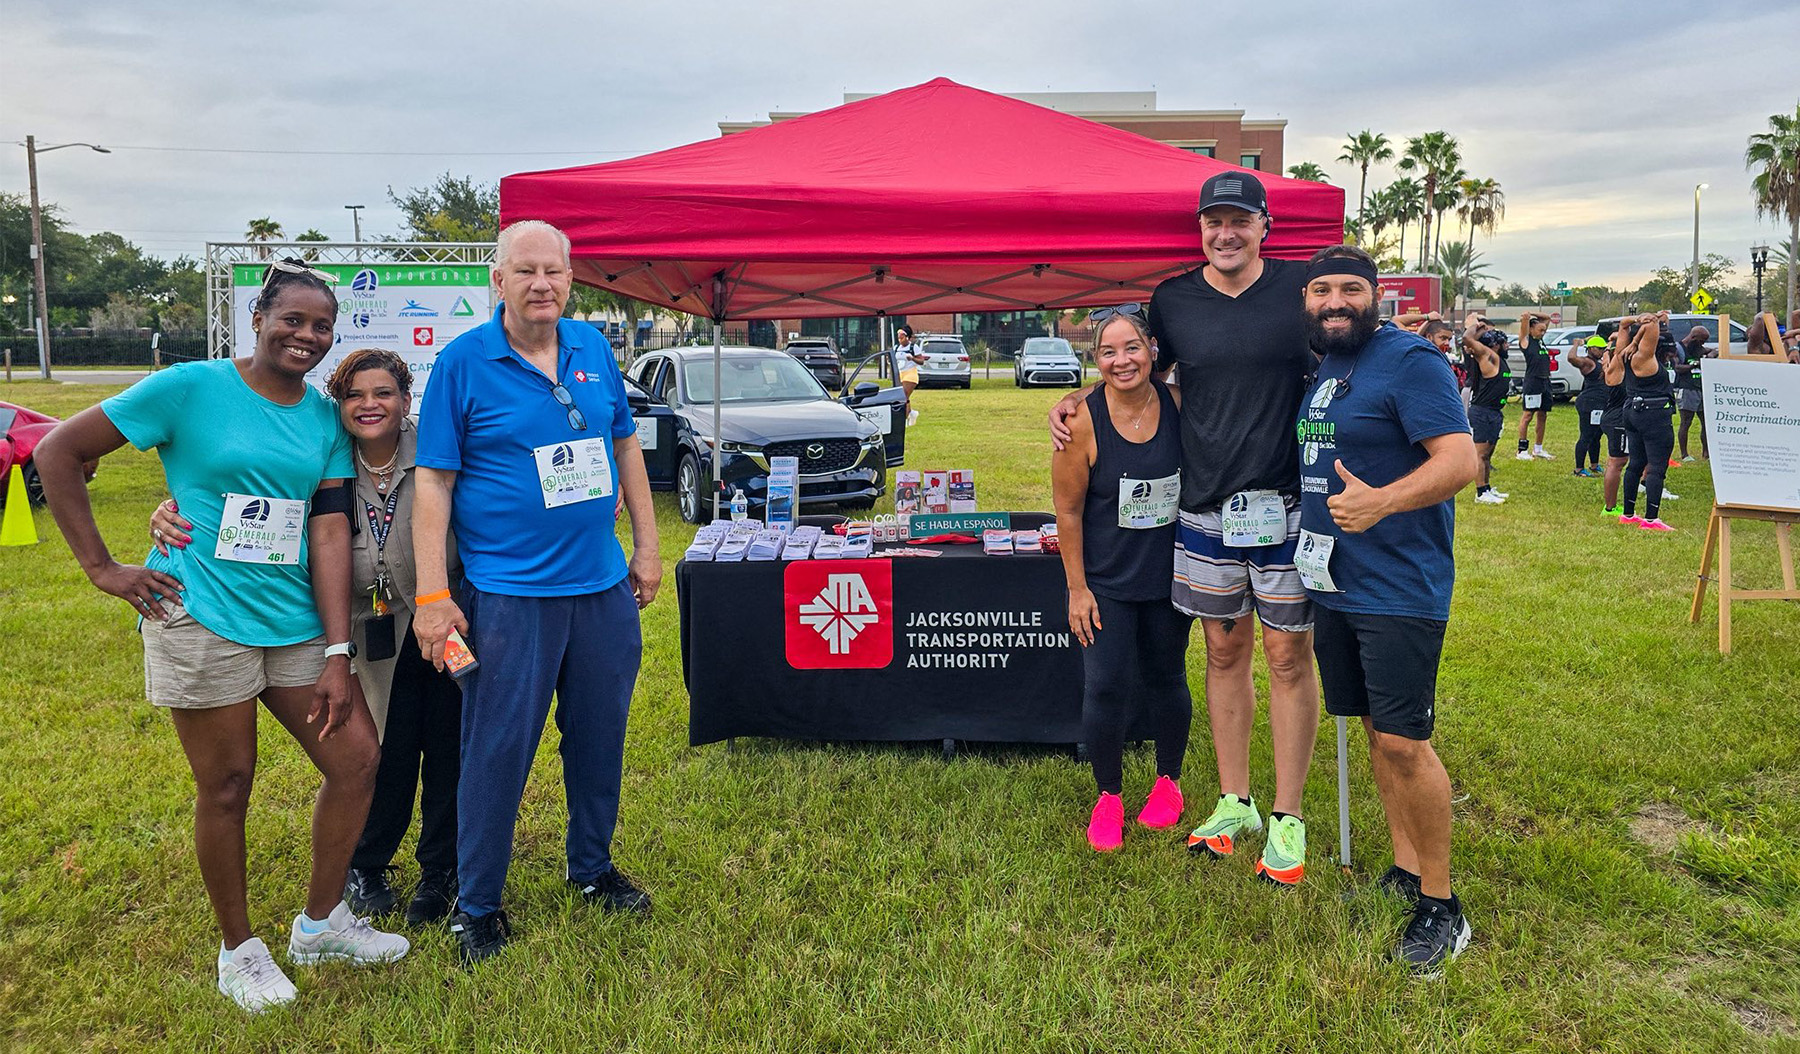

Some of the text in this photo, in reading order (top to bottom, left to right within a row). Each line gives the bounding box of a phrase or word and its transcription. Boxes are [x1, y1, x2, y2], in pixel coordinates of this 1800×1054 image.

[385, 271, 480, 281] SPONSORS!
[353, 291, 375, 299] VyStar
[354, 300, 388, 309] EMERALD
[1713, 382, 1768, 396] Everyone
[1714, 395, 1780, 409] is welcome.
[1308, 408, 1326, 421] VyStar
[1715, 410, 1800, 426] Discrimination
[1307, 422, 1335, 435] EMERALD
[1717, 423, 1750, 435] is not.
[554, 465, 575, 475] VyStar
[557, 471, 587, 483] EMERALD
[588, 487, 603, 497] 466
[1132, 503, 1158, 512] EMERALD
[240, 519, 265, 530] VyStar
[914, 517, 1006, 531] SE HABLA ESPAÑOL
[1156, 516, 1169, 525] 460
[239, 530, 276, 541] EMERALD
[1258, 535, 1273, 544] 462
[268, 552, 285, 562] 461
[906, 611, 1042, 627] JACKSONVILLE
[906, 632, 1070, 649] TRANSPORTATION
[906, 653, 1010, 669] AUTHORITY
